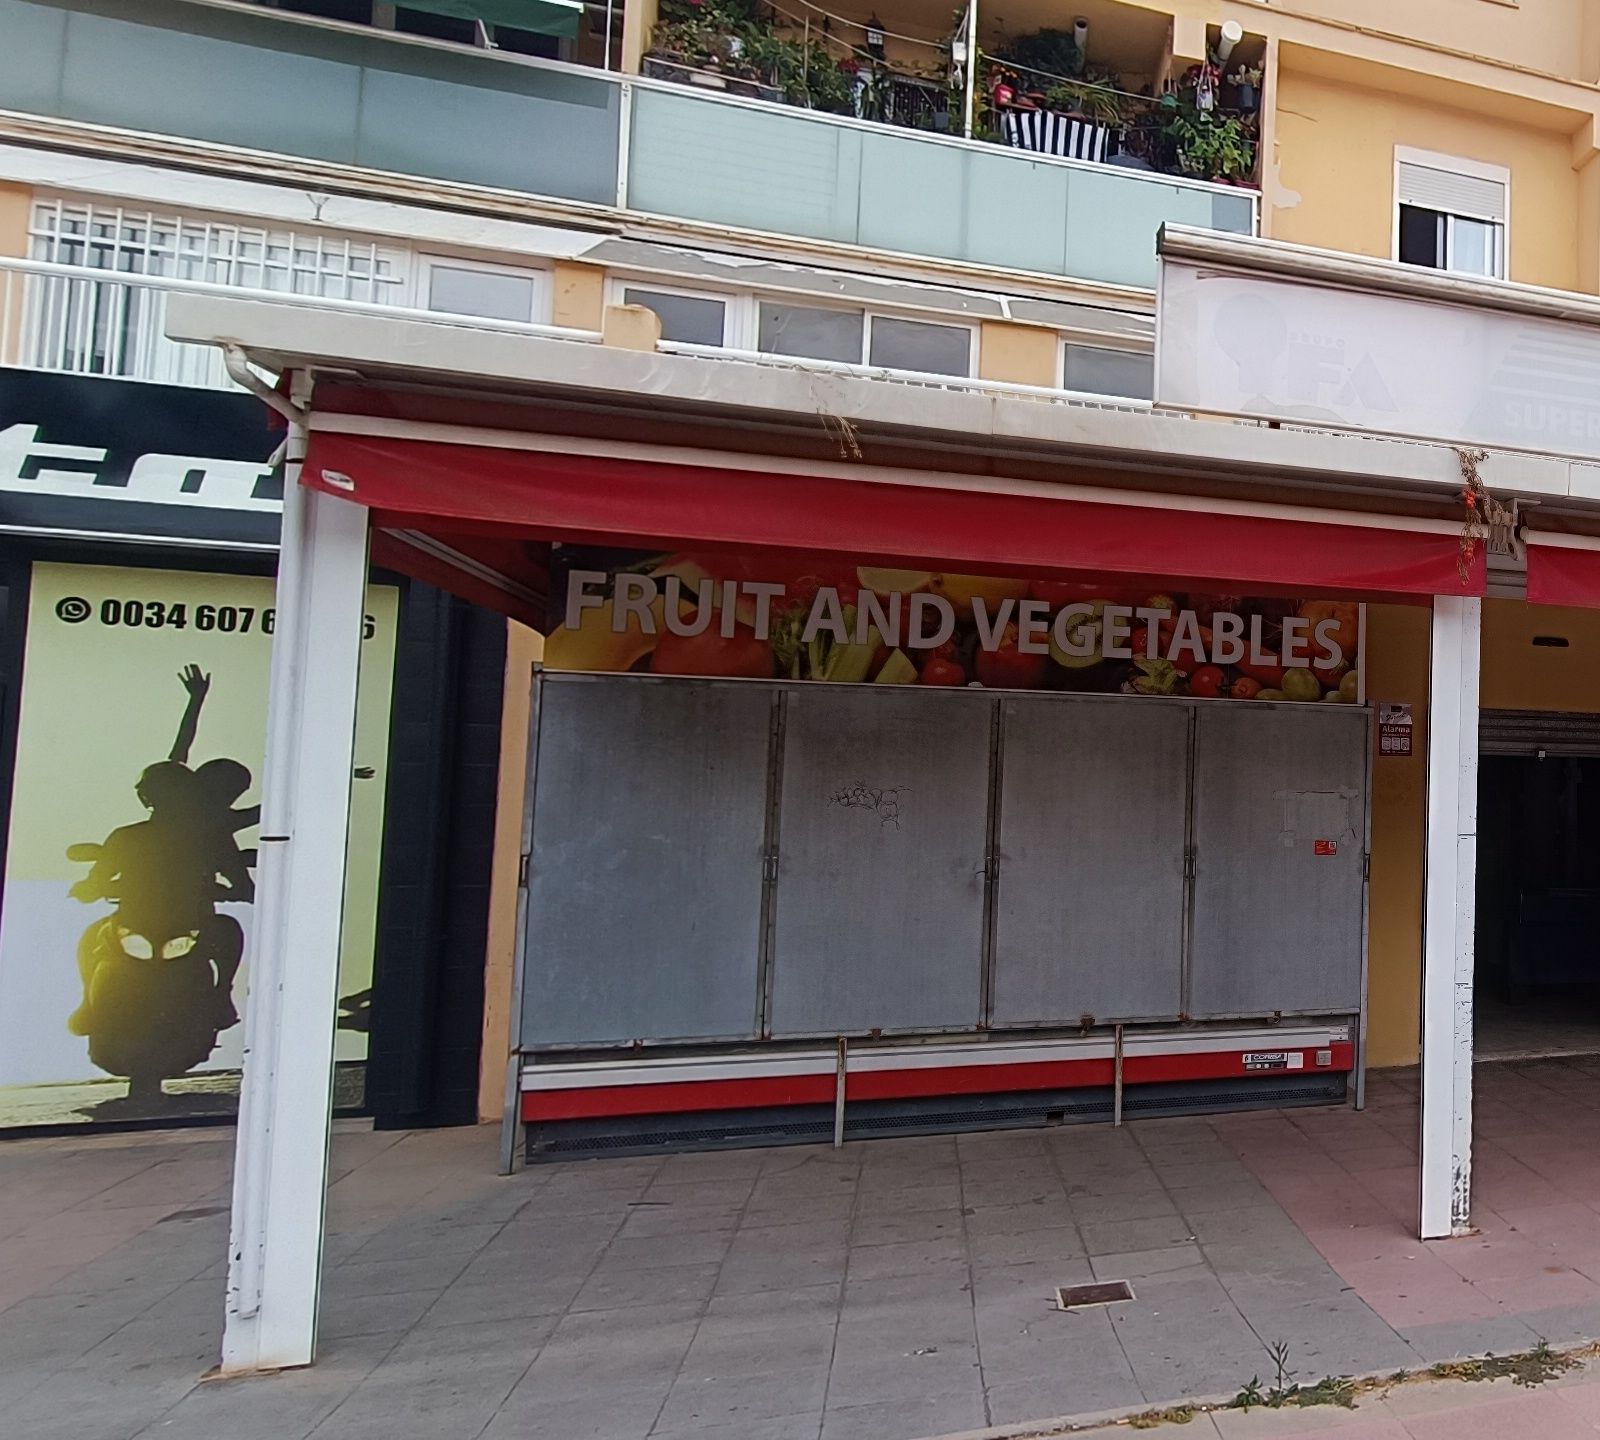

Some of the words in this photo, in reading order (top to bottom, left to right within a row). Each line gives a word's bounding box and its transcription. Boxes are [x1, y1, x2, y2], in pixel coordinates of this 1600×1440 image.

[100, 598, 187, 630] 0034
[196, 606, 254, 634] 607
[564, 569, 787, 641] FRUIT
[801, 584, 957, 652] AND
[969, 596, 1344, 671] VEGETABLES
[1382, 724, 1411, 733] Alarma
